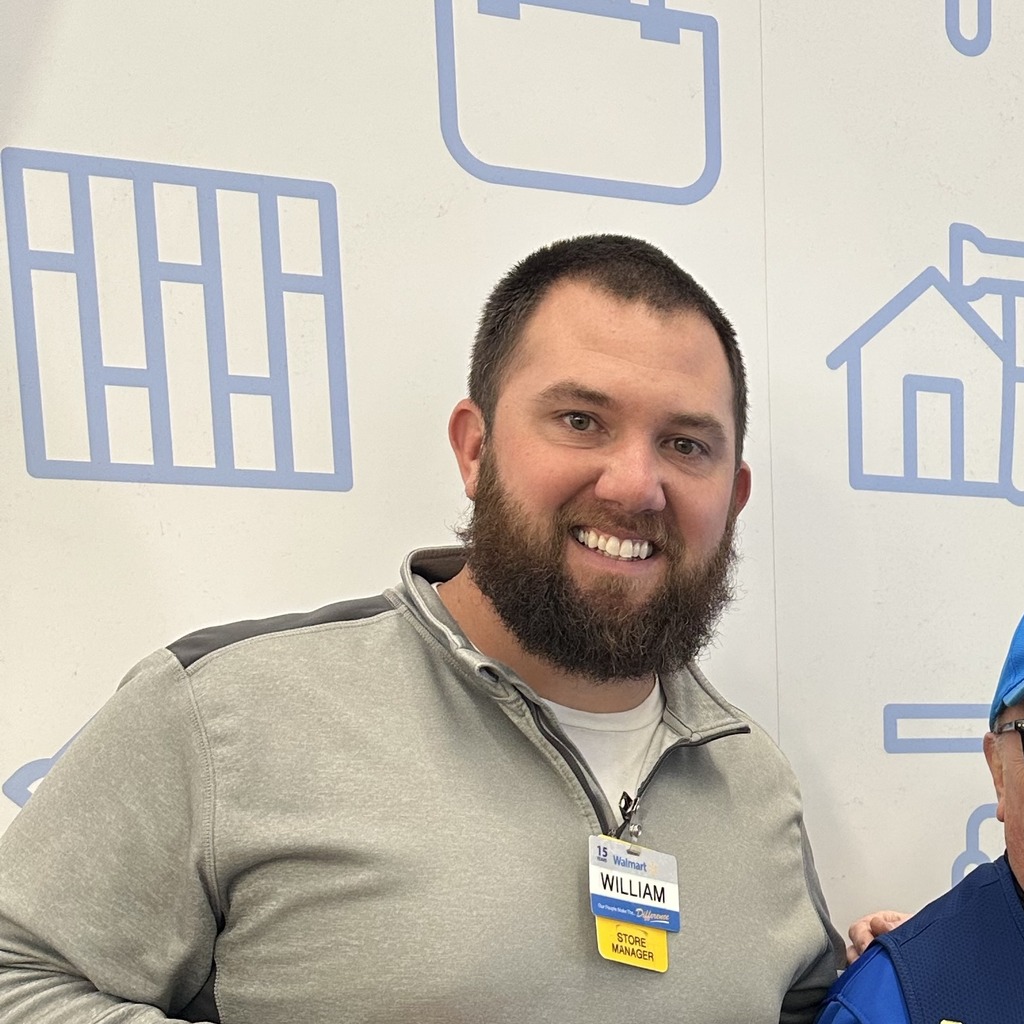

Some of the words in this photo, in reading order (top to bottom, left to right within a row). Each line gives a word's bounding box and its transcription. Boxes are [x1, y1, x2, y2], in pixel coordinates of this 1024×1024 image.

[597, 846, 608, 857] 15
[613, 855, 647, 872] Walmart
[600, 872, 665, 903] WILLIAM
[617, 932, 646, 948] STORE
[612, 943, 655, 962] MANAGER
